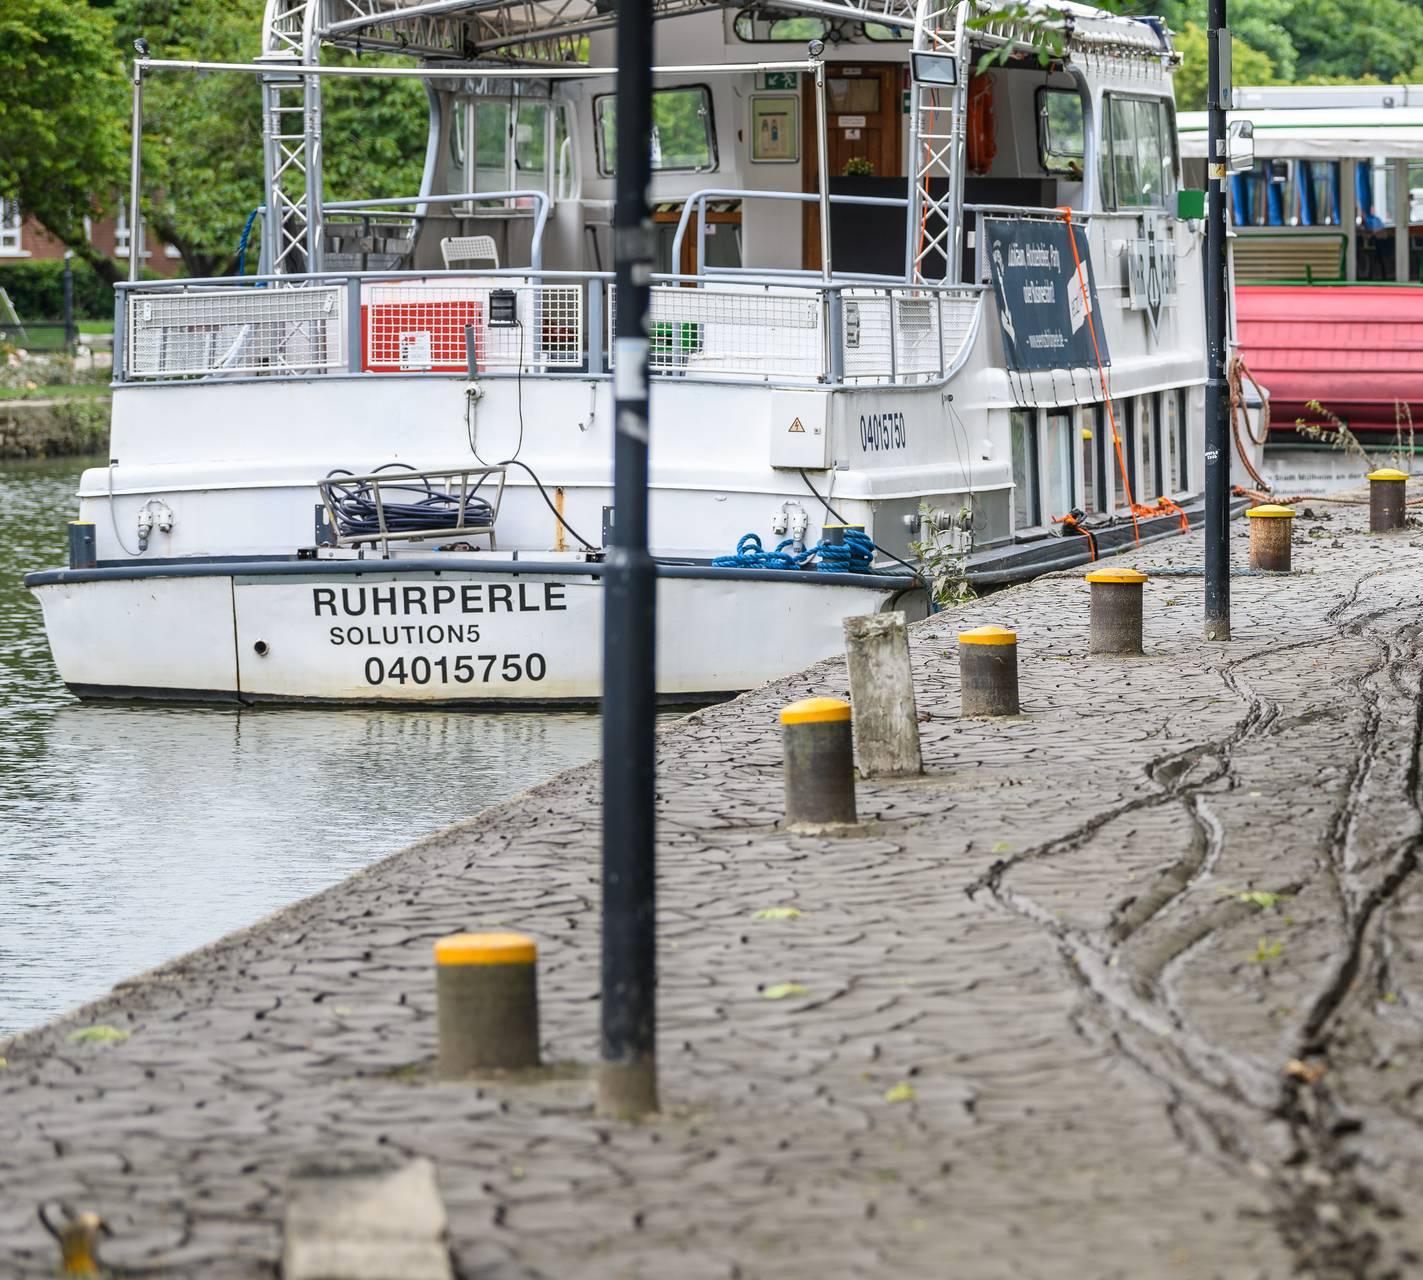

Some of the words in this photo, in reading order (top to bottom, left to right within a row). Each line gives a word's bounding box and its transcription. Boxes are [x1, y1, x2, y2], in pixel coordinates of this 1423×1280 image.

[860, 412, 906, 452] 04015750
[313, 583, 567, 616] RUHRPERLE
[330, 624, 480, 645] SOLUTION5
[364, 653, 547, 685] 04015750
